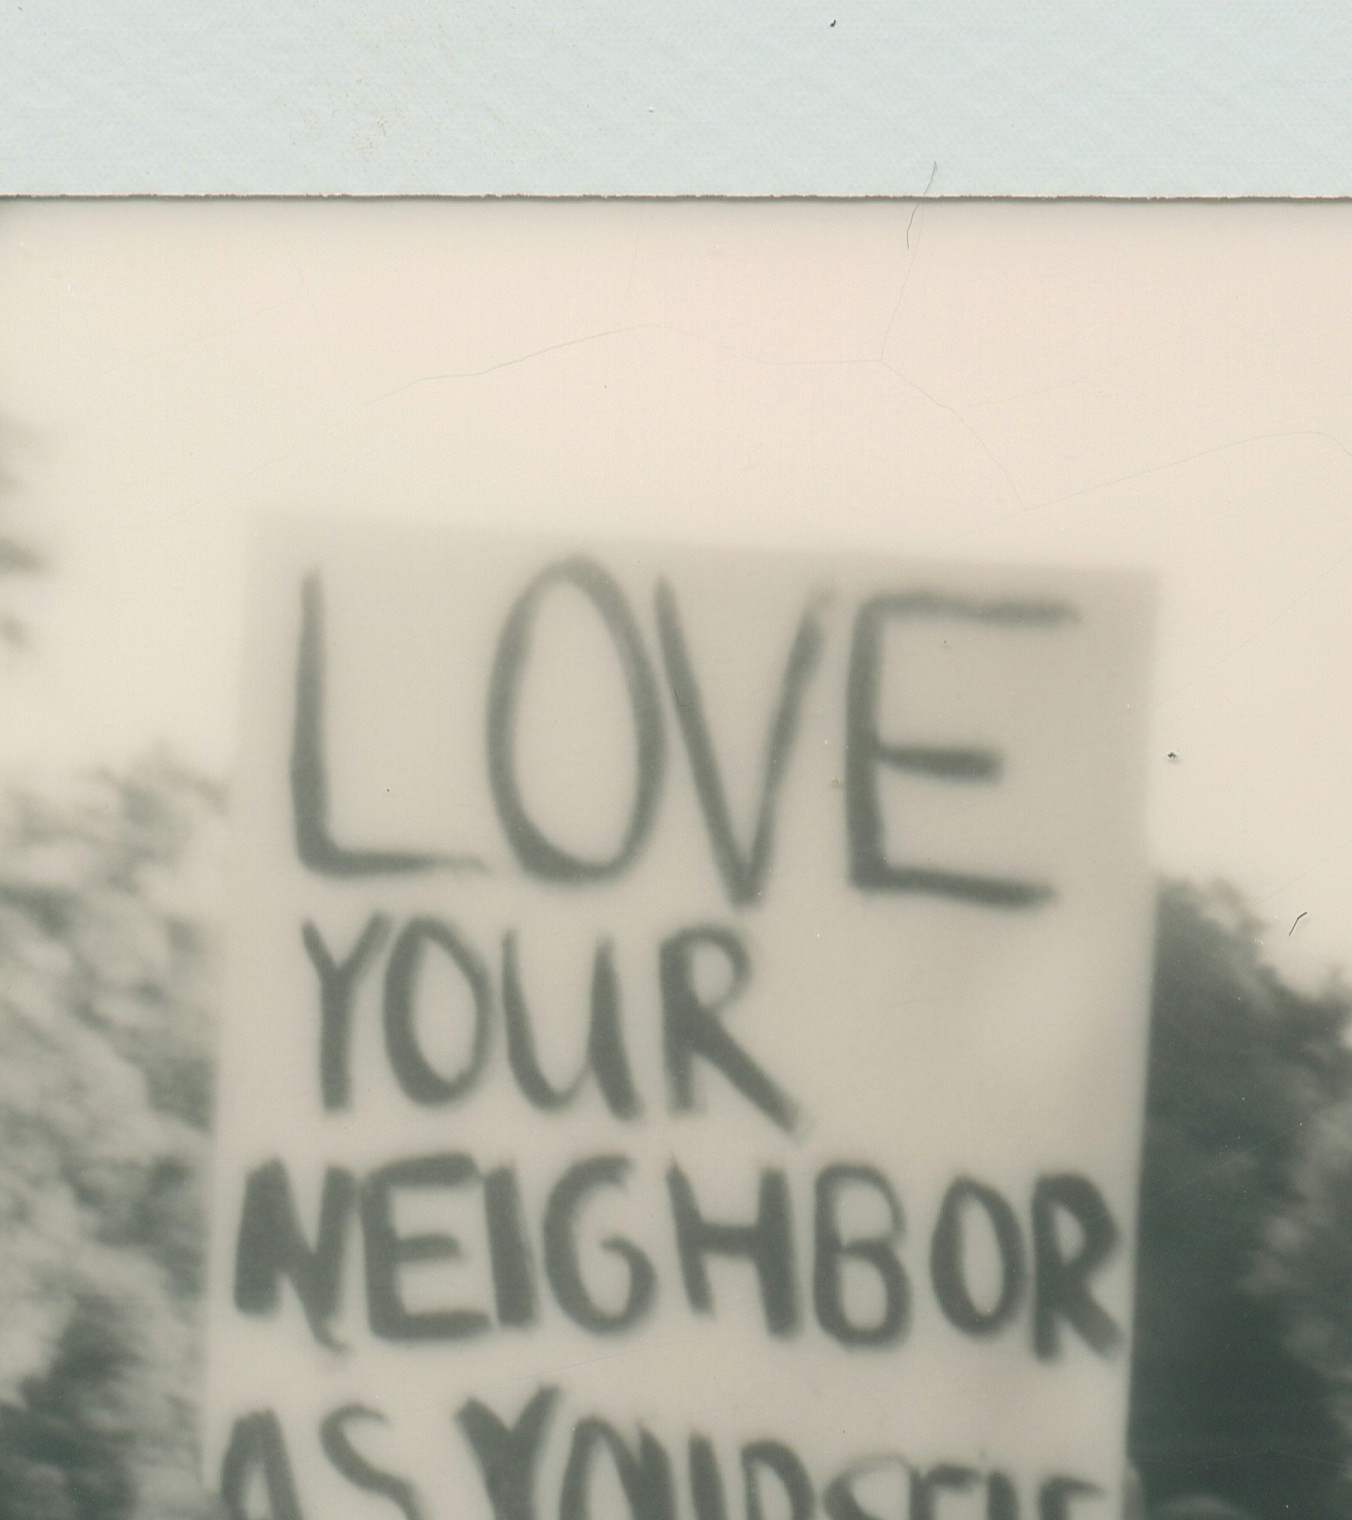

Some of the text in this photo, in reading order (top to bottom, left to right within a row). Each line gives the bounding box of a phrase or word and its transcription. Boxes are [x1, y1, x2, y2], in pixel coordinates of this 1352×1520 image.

[289, 554, 1083, 910] LOVE
[300, 910, 813, 1142] YOUR
[232, 1152, 1128, 1362] NEIGHBOR
